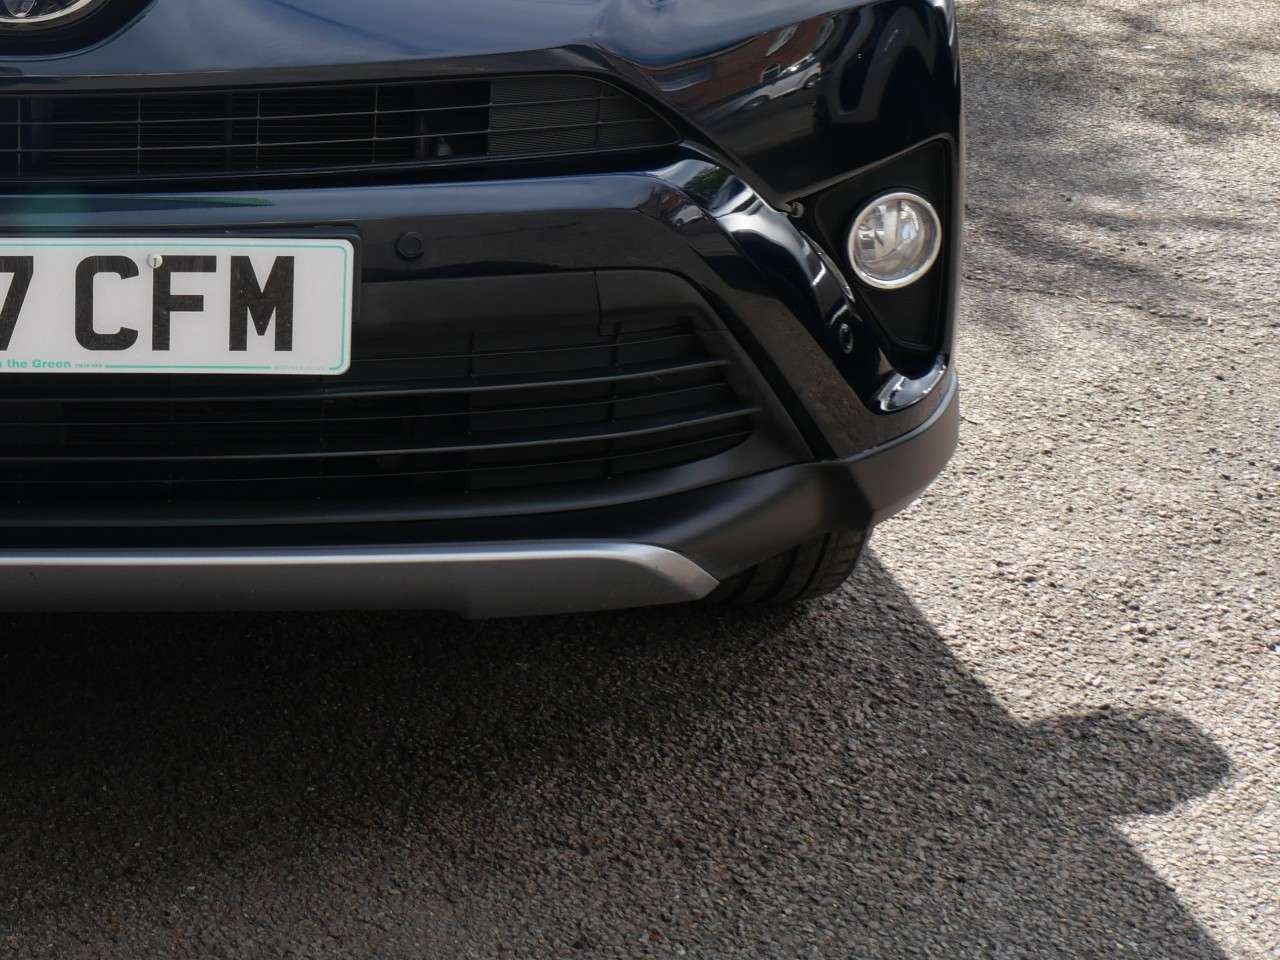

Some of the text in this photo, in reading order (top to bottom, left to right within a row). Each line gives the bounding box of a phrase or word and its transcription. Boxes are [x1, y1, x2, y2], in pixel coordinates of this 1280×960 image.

[74, 255, 295, 352] CFM
[7, 358, 28, 369] the
[32, 358, 71, 369] Green
